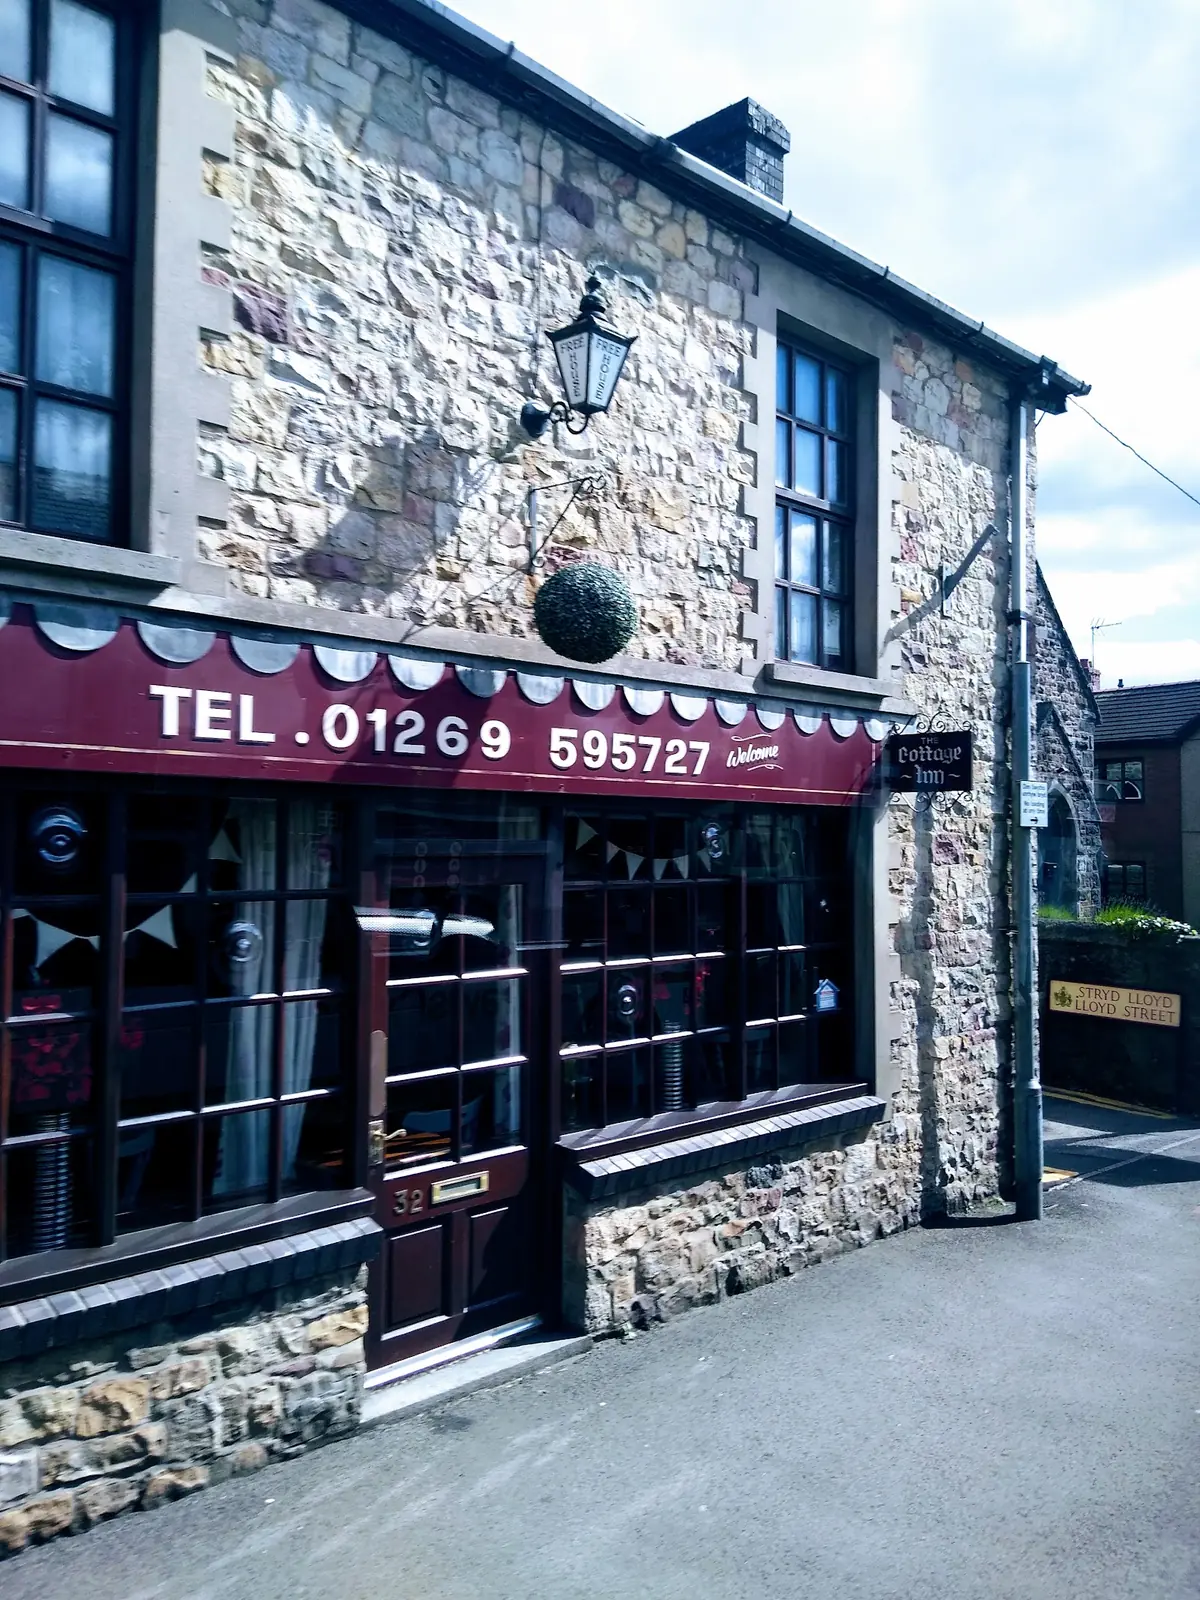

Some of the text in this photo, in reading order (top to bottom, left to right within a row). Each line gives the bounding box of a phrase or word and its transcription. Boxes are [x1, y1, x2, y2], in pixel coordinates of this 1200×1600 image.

[561, 336, 585, 354] FREE
[596, 338, 623, 358] FREE
[569, 352, 581, 397] HOUSE
[596, 354, 612, 400] HOUSE
[321, 703, 512, 759] 01269
[549, 727, 710, 775] 595727
[920, 736, 940, 745] THE
[726, 743, 779, 768] Welcome
[898, 746, 962, 764] Cottage
[914, 764, 945, 785] Inn
[1078, 986, 1173, 1009] STRYD LLOYD
[1075, 999, 1176, 1023] LLOYD STREET
[393, 1189, 424, 1215] 32
